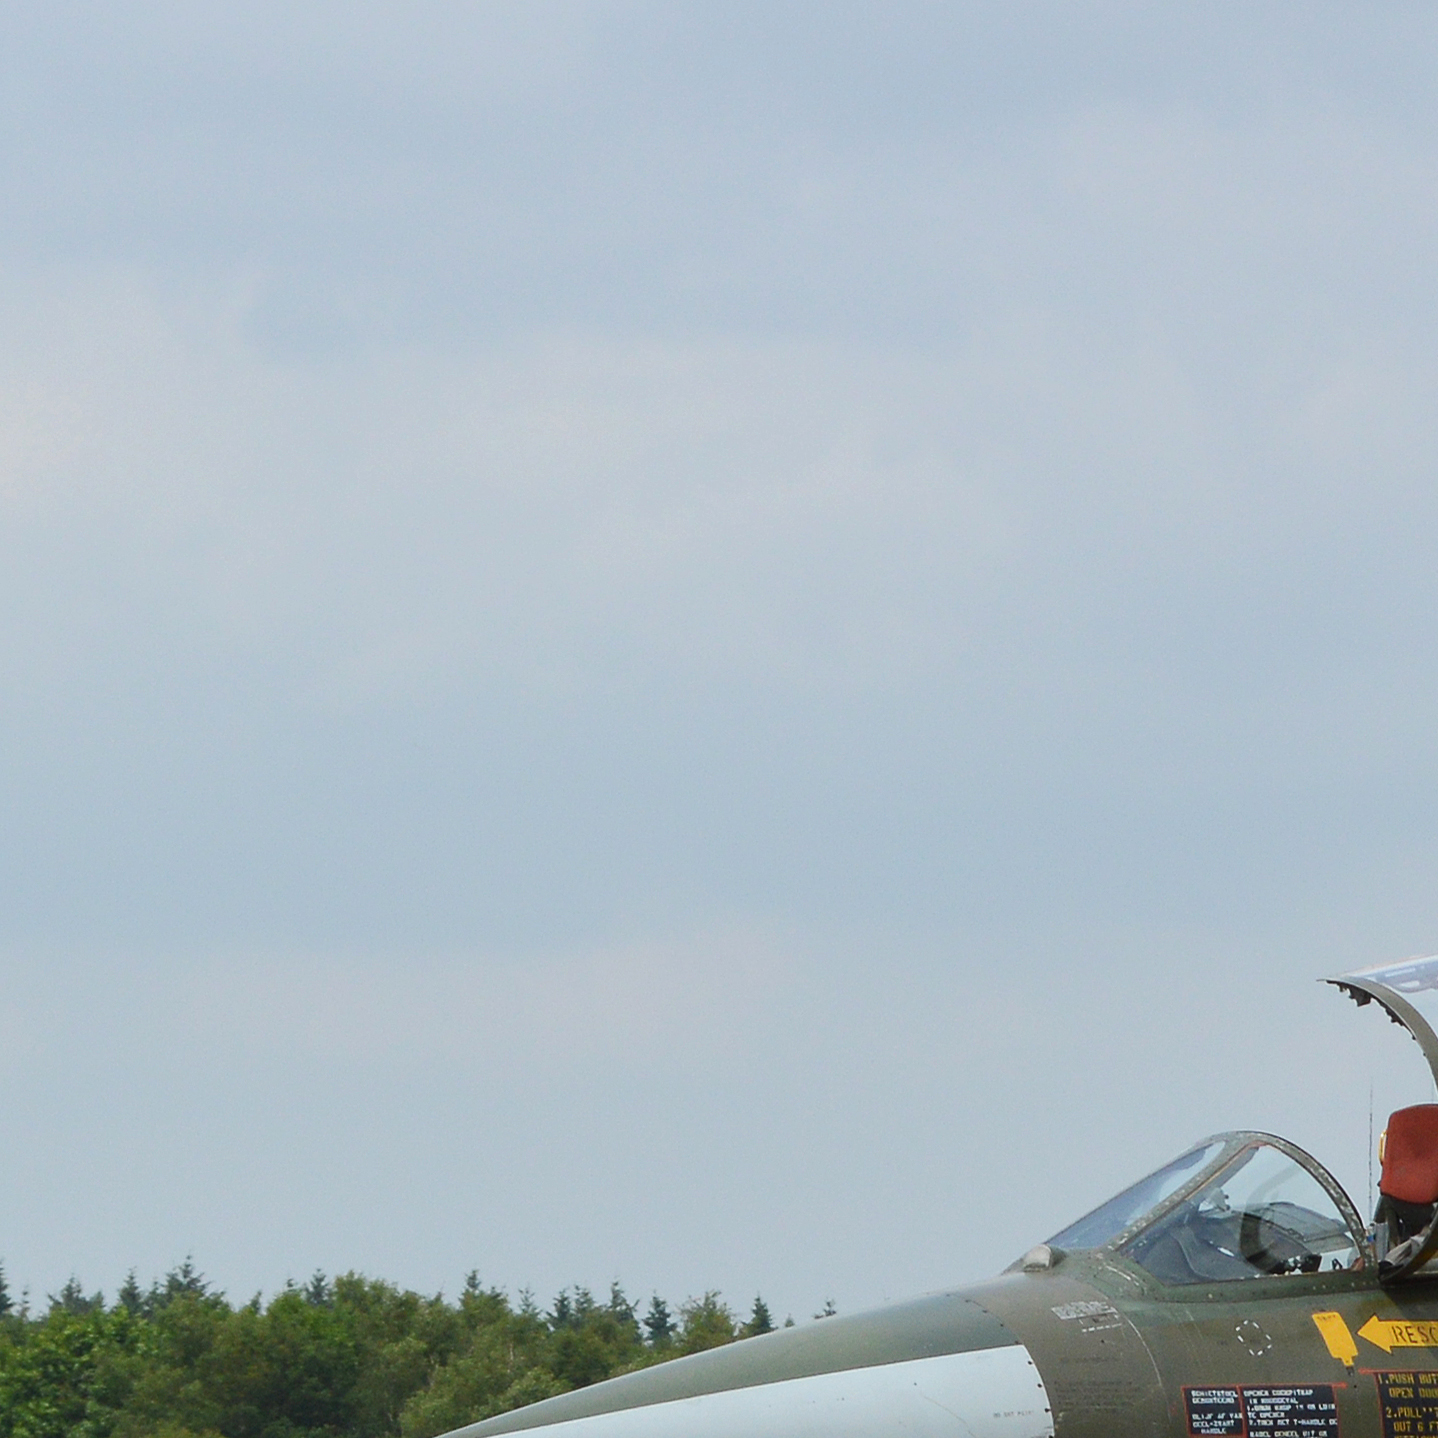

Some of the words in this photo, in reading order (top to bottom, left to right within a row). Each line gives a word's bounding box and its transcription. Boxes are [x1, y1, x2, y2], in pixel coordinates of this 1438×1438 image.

[1388, 1387, 1414, 1398] OPEN
[1393, 1421, 1411, 1432] OUT
[1417, 1421, 1424, 1432] 6
